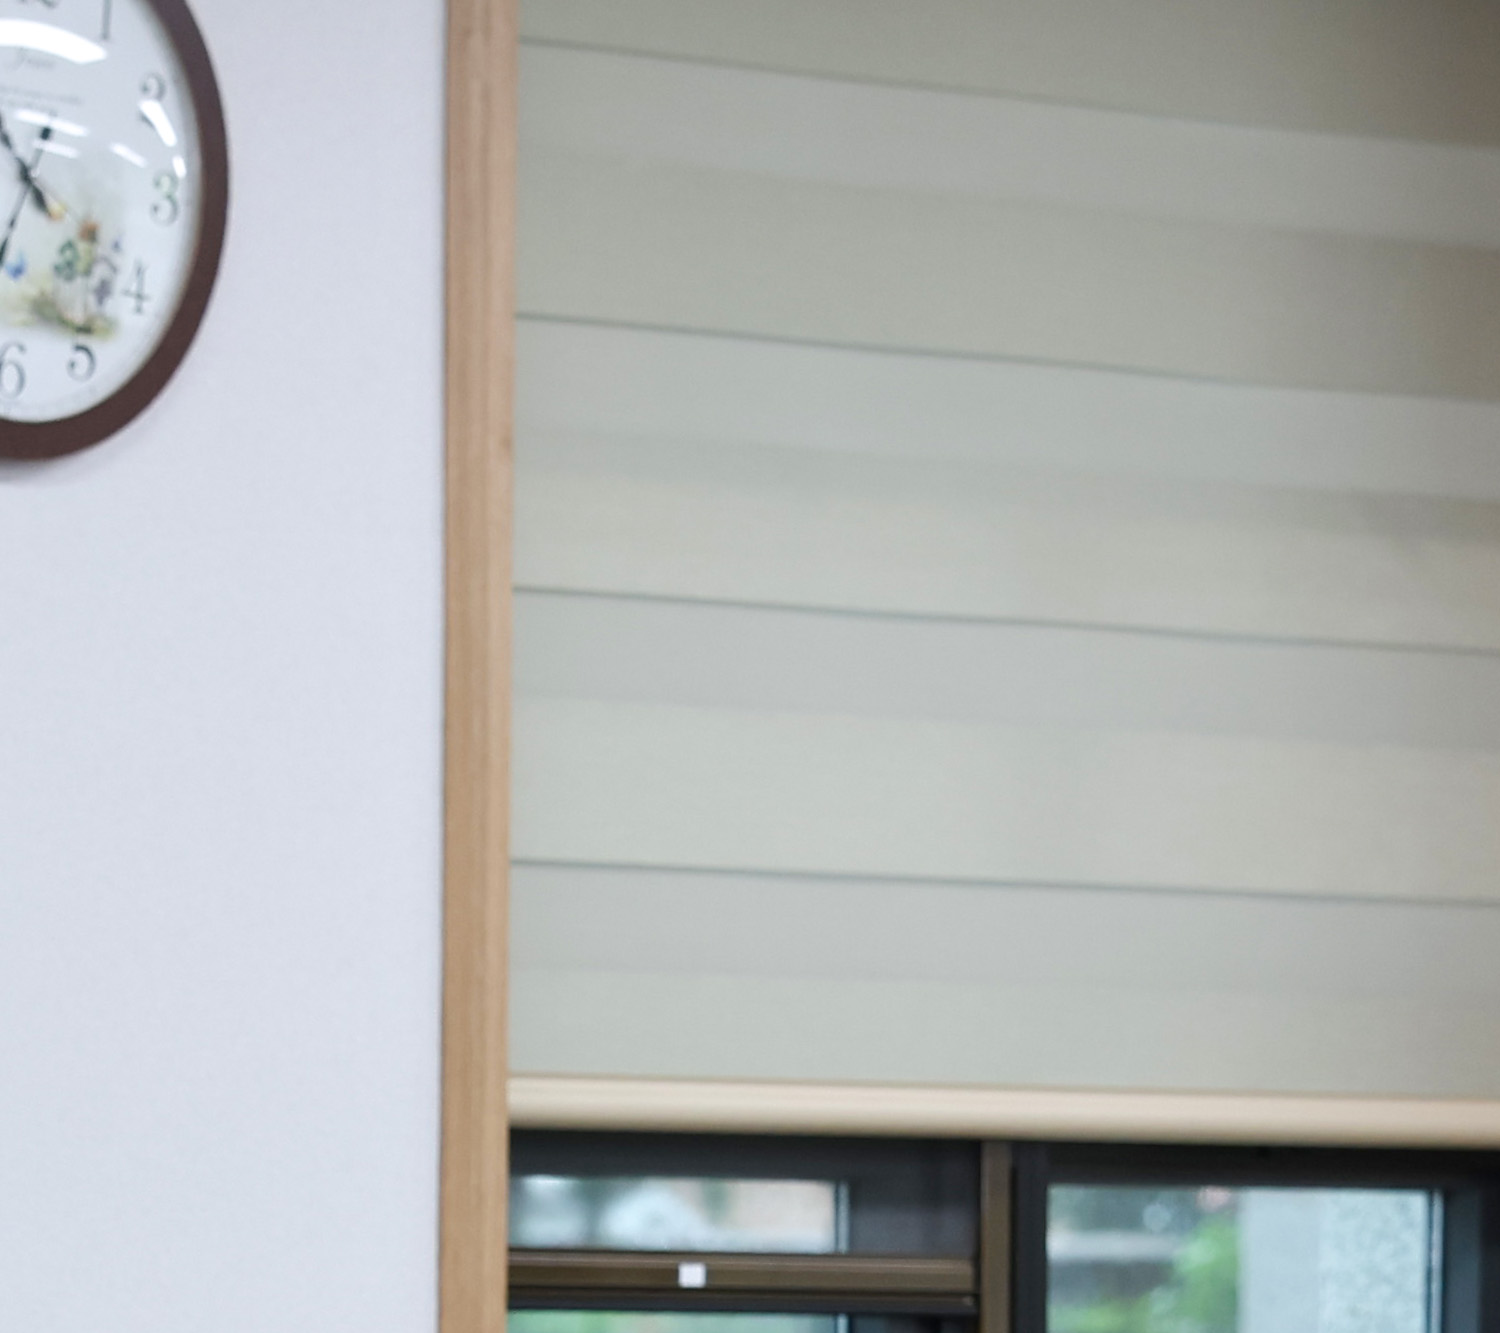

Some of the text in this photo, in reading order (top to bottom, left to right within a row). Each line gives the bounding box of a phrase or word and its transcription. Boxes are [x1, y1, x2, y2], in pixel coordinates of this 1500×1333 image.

[149, 170, 180, 226] 3
[121, 259, 152, 314] 4
[66, 324, 97, 381] 5
